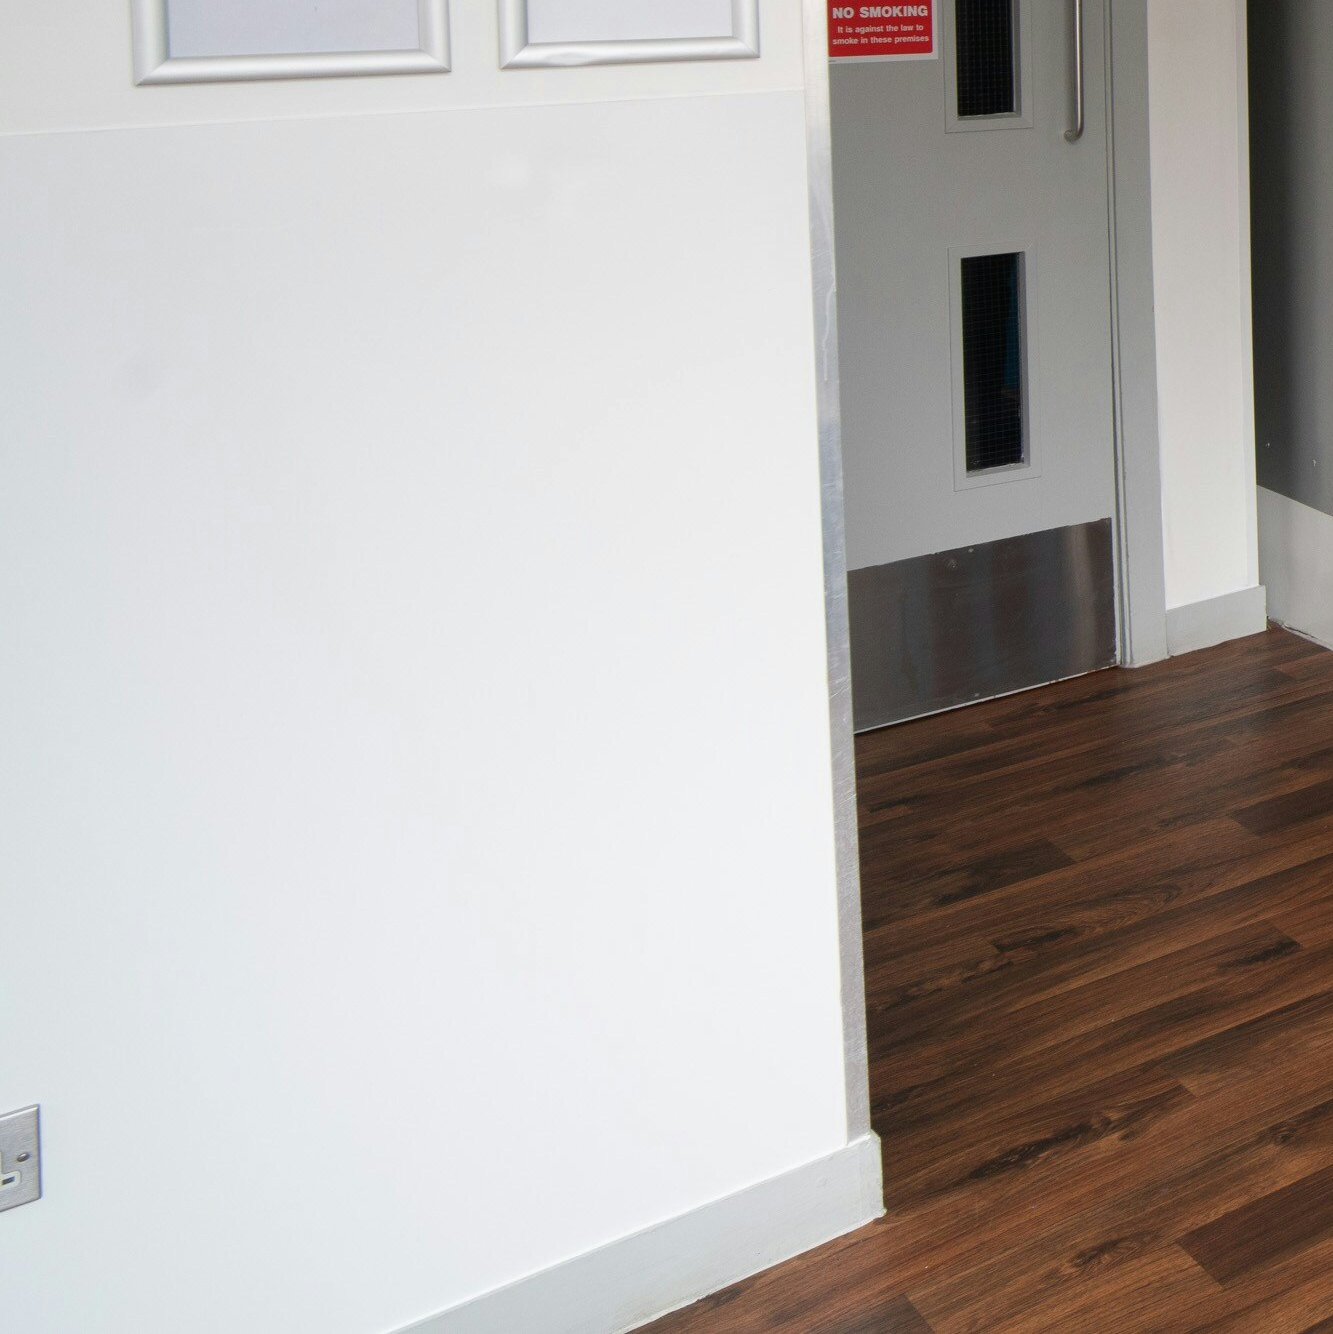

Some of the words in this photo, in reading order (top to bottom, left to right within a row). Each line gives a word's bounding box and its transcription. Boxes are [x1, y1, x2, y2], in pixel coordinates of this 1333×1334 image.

[832, 7, 855, 19] NO
[859, 5, 928, 18] SMOKING
[855, 25, 884, 34] against
[886, 24, 898, 32] the
[832, 37, 858, 45] smoke
[861, 36, 868, 44] in
[870, 36, 892, 44] these
[894, 35, 929, 44] premises
